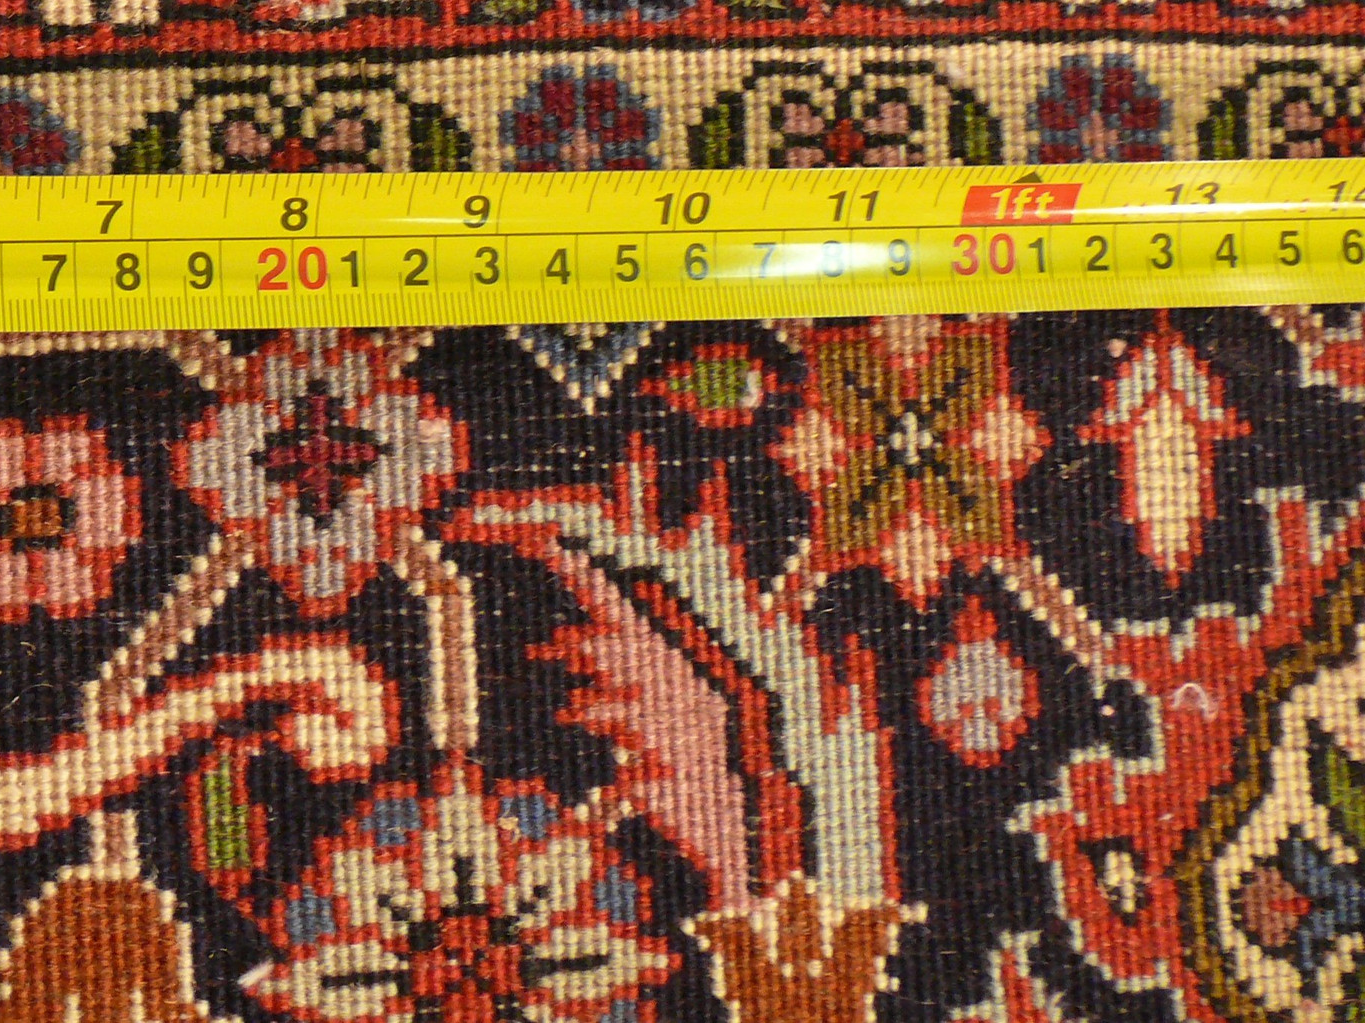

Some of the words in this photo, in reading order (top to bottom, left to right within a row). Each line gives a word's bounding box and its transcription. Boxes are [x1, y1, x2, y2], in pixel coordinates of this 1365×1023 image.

[96, 200, 123, 234] 7
[280, 197, 309, 231] 8
[463, 195, 491, 228] 9
[654, 192, 711, 225] 10
[827, 190, 880, 222] 11
[990, 186, 1054, 220] 1ft
[1165, 182, 1220, 213] 13
[42, 255, 67, 291] 7
[115, 253, 142, 290] 8
[187, 252, 214, 289] 9
[258, 247, 328, 291] 20
[341, 250, 359, 287] 1
[402, 248, 429, 287] 2
[474, 247, 500, 285] 3
[546, 248, 570, 284] 4
[616, 244, 640, 282] 5
[684, 243, 709, 280] 6
[754, 243, 777, 278] 7
[821, 240, 844, 277] 8
[888, 239, 911, 275] 9
[951, 234, 1016, 276] 30
[1028, 237, 1046, 273] 1
[1085, 235, 1109, 271] 2
[1150, 233, 1173, 269] 3
[1215, 234, 1238, 268] 4
[1279, 231, 1301, 266] 5
[1342, 229, 1364, 264] 6
